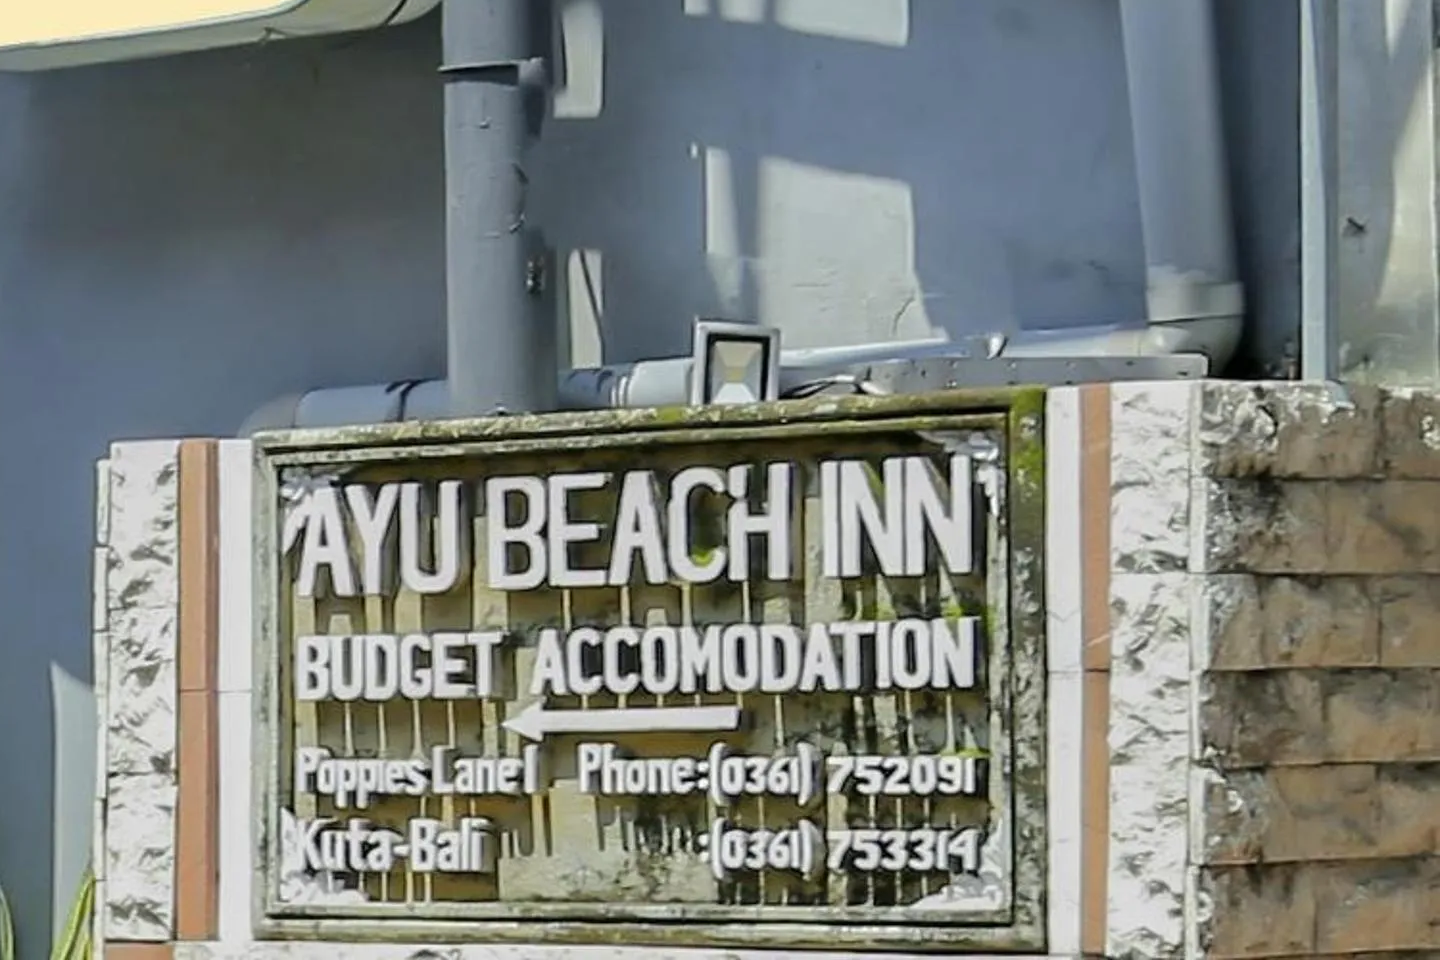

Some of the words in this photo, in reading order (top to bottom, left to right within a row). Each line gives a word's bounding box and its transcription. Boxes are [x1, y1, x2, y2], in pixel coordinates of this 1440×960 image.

[297, 480, 462, 596] AYU
[486, 462, 792, 590] BEACH
[821, 454, 972, 578] INN
[296, 630, 504, 701] BUDGET
[531, 617, 976, 696] ACCOMODATION
[295, 746, 428, 808] Poppies
[827, 756, 975, 795] 752091
[300, 816, 490, 872] Kuta-Bali
[827, 830, 980, 872] 753314
